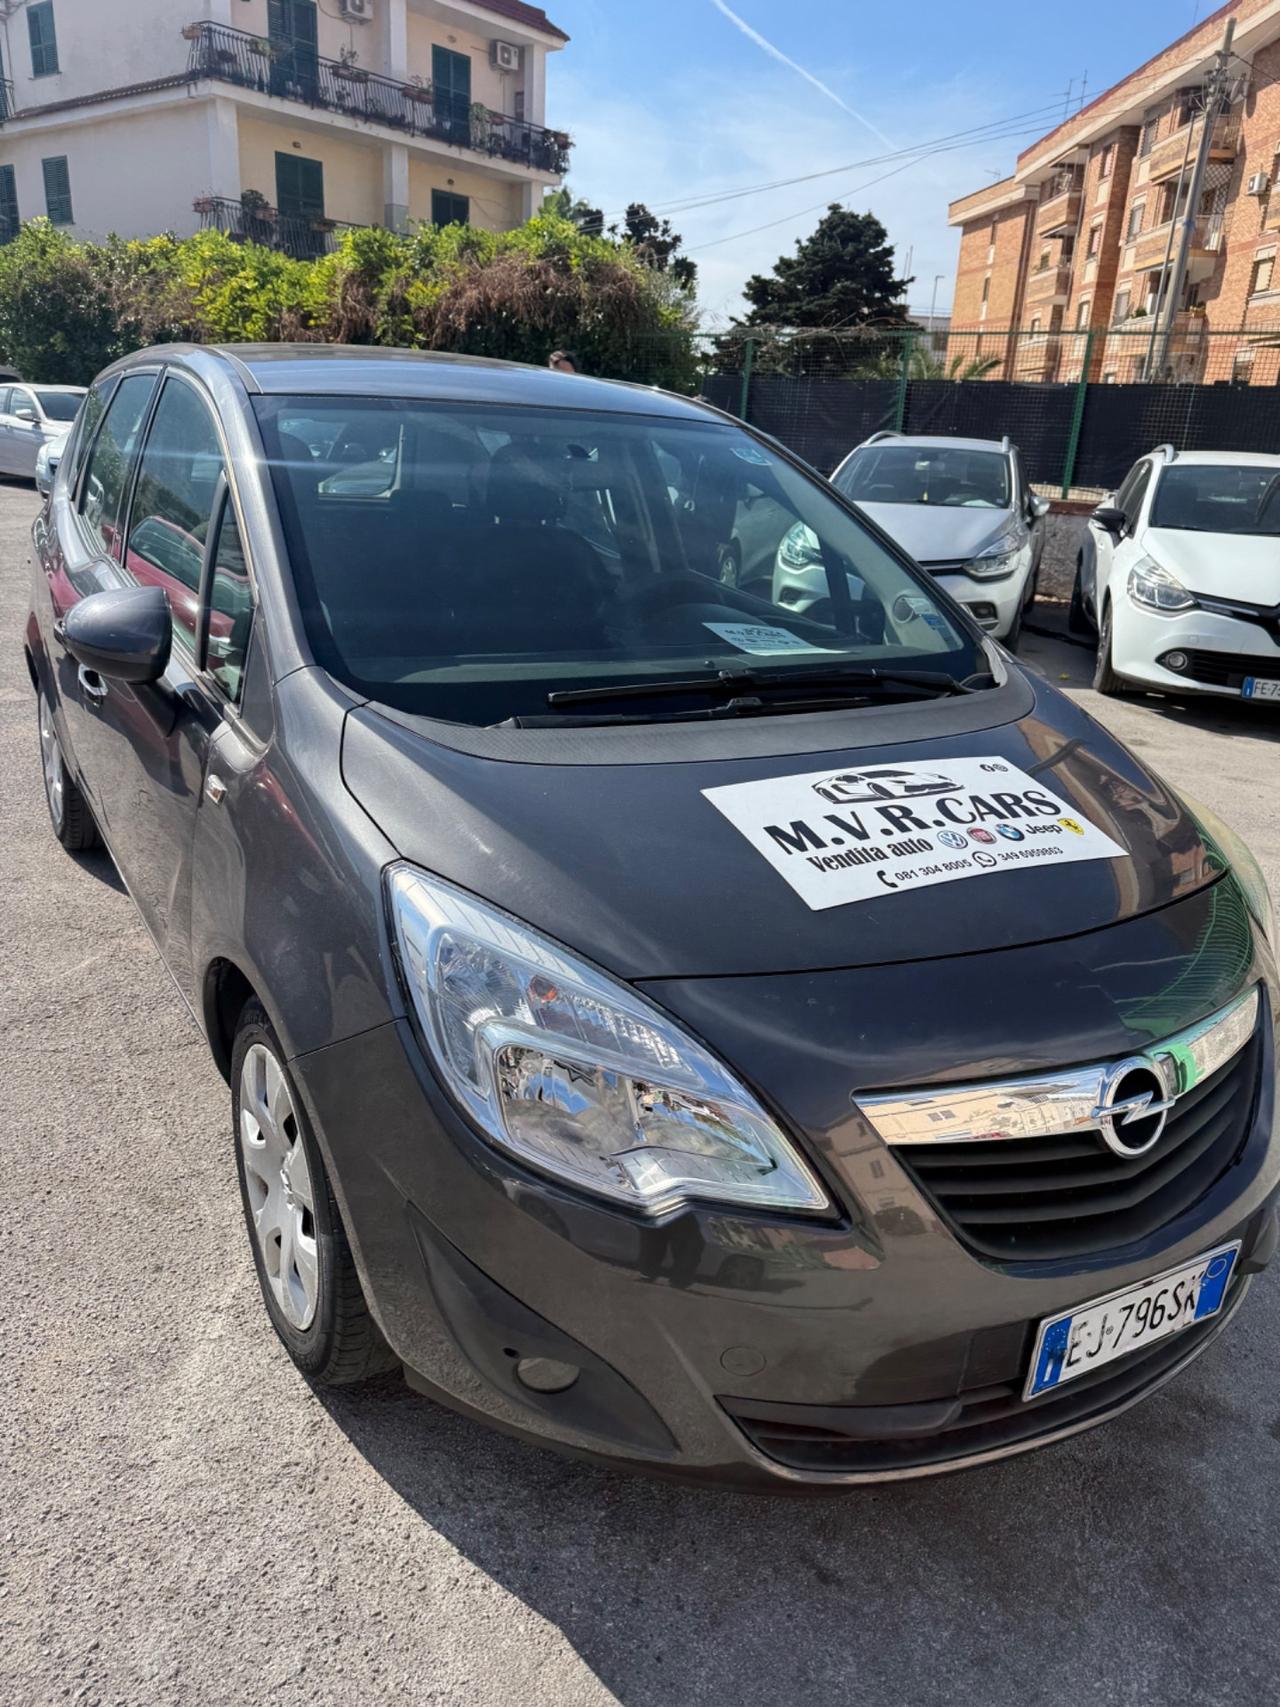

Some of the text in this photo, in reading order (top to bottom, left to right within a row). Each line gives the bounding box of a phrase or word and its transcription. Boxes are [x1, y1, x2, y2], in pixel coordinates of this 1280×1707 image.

[763, 790, 1062, 855] M.V.R.CARS
[1026, 823, 1063, 834] Jeep
[806, 845, 888, 873] Vendita
[887, 838, 934, 858] auto
[998, 850, 1019, 862] 349
[895, 870, 919, 882] 081
[919, 865, 942, 877] 304
